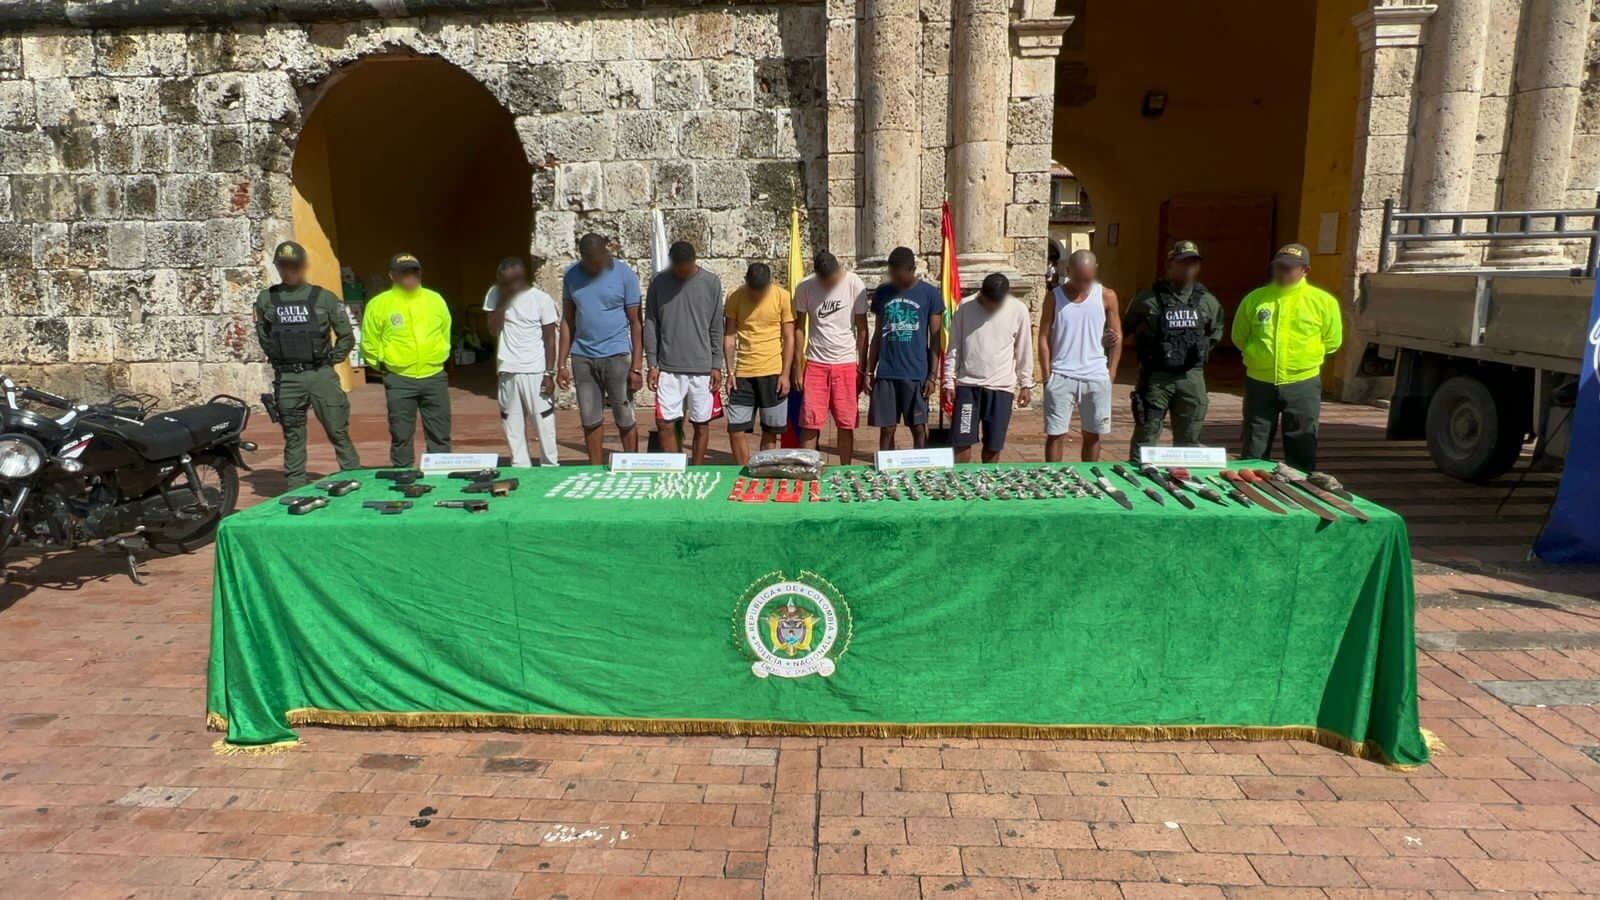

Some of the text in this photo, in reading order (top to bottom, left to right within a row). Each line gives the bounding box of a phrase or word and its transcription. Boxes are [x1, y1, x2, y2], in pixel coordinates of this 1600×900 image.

[276, 306, 309, 316] GAULA
[821, 300, 841, 311] NIKE
[1165, 310, 1199, 320] GAULA
[785, 584, 799, 593] DE
[807, 590, 834, 632] COLOMBIA
[792, 640, 832, 667] NACIONAL
